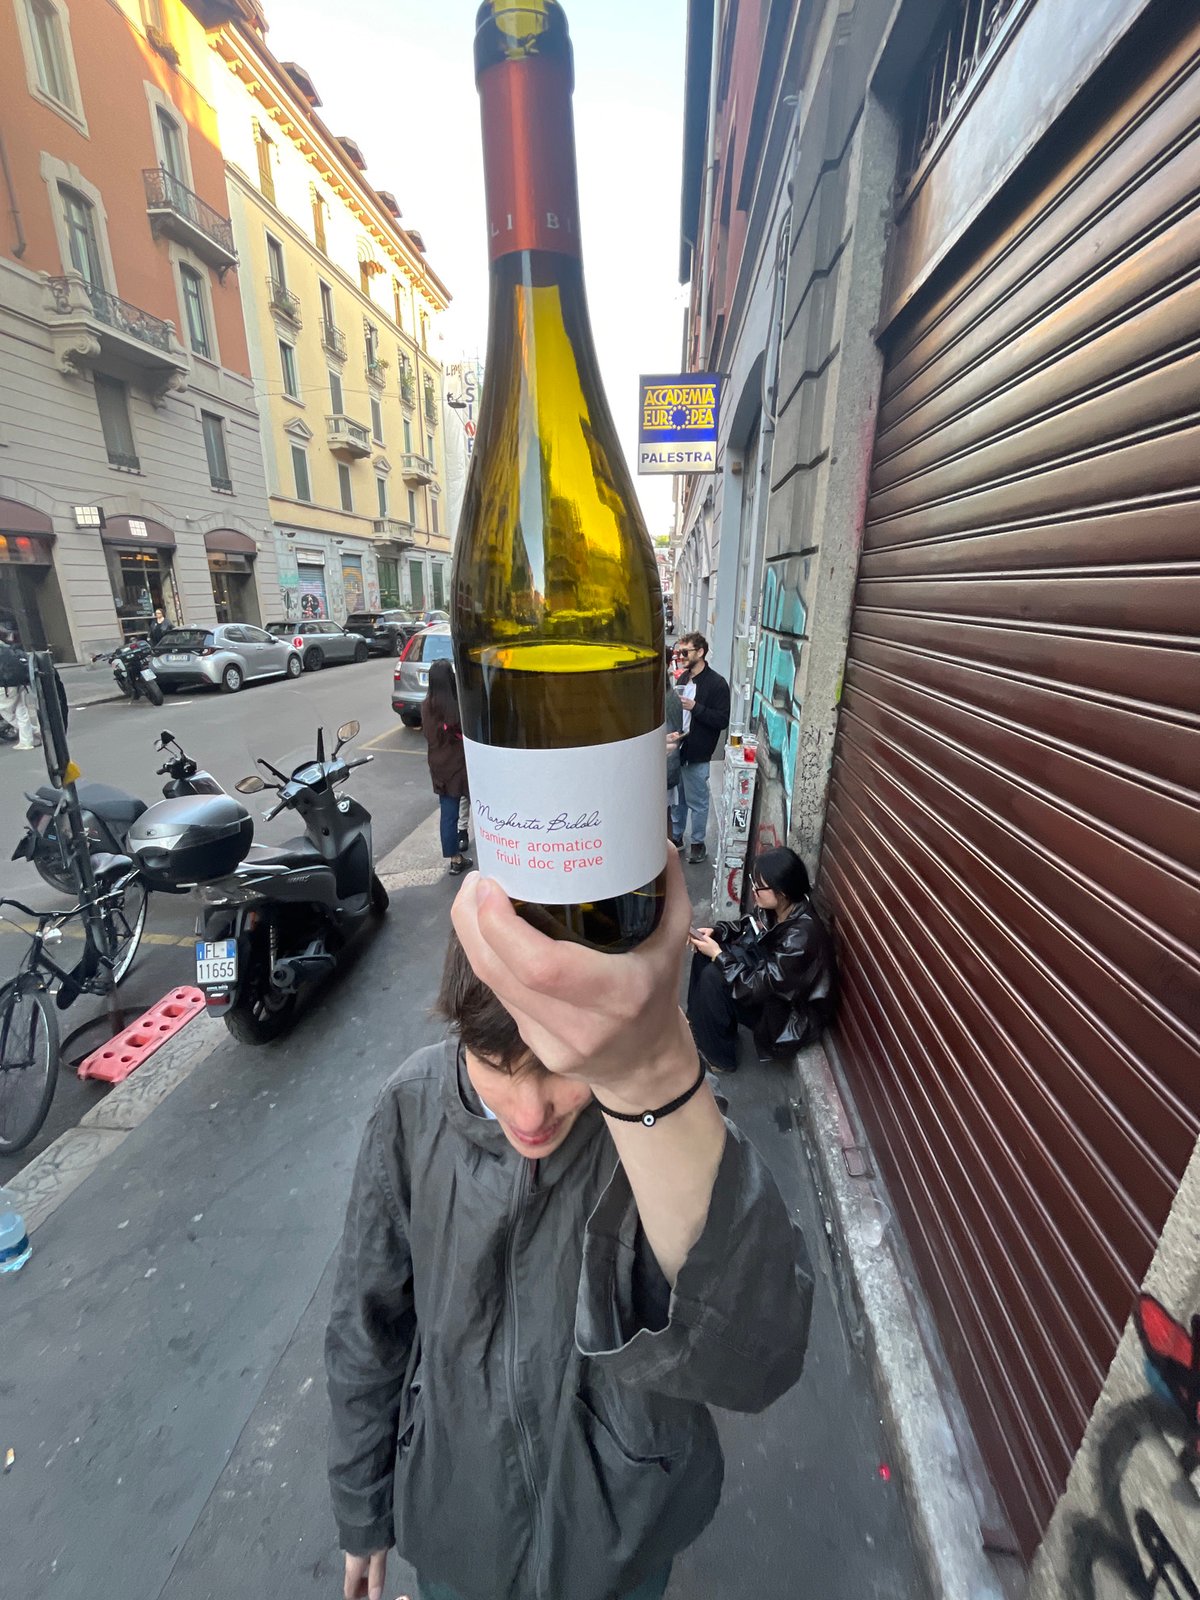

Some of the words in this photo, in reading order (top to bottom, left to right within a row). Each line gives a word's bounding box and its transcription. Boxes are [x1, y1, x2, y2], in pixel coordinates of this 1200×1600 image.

[644, 388, 715, 405] ACCADEMIA
[641, 452, 712, 463] PALESTRA
[476, 799, 545, 831] Margherita
[480, 827, 520, 849] traminer
[527, 838, 603, 853] aromatico
[496, 849, 521, 867] friuli
[528, 856, 555, 870] doc
[563, 855, 604, 873] grave
[205, 943, 219, 958] FL
[199, 962, 234, 979] 11655
